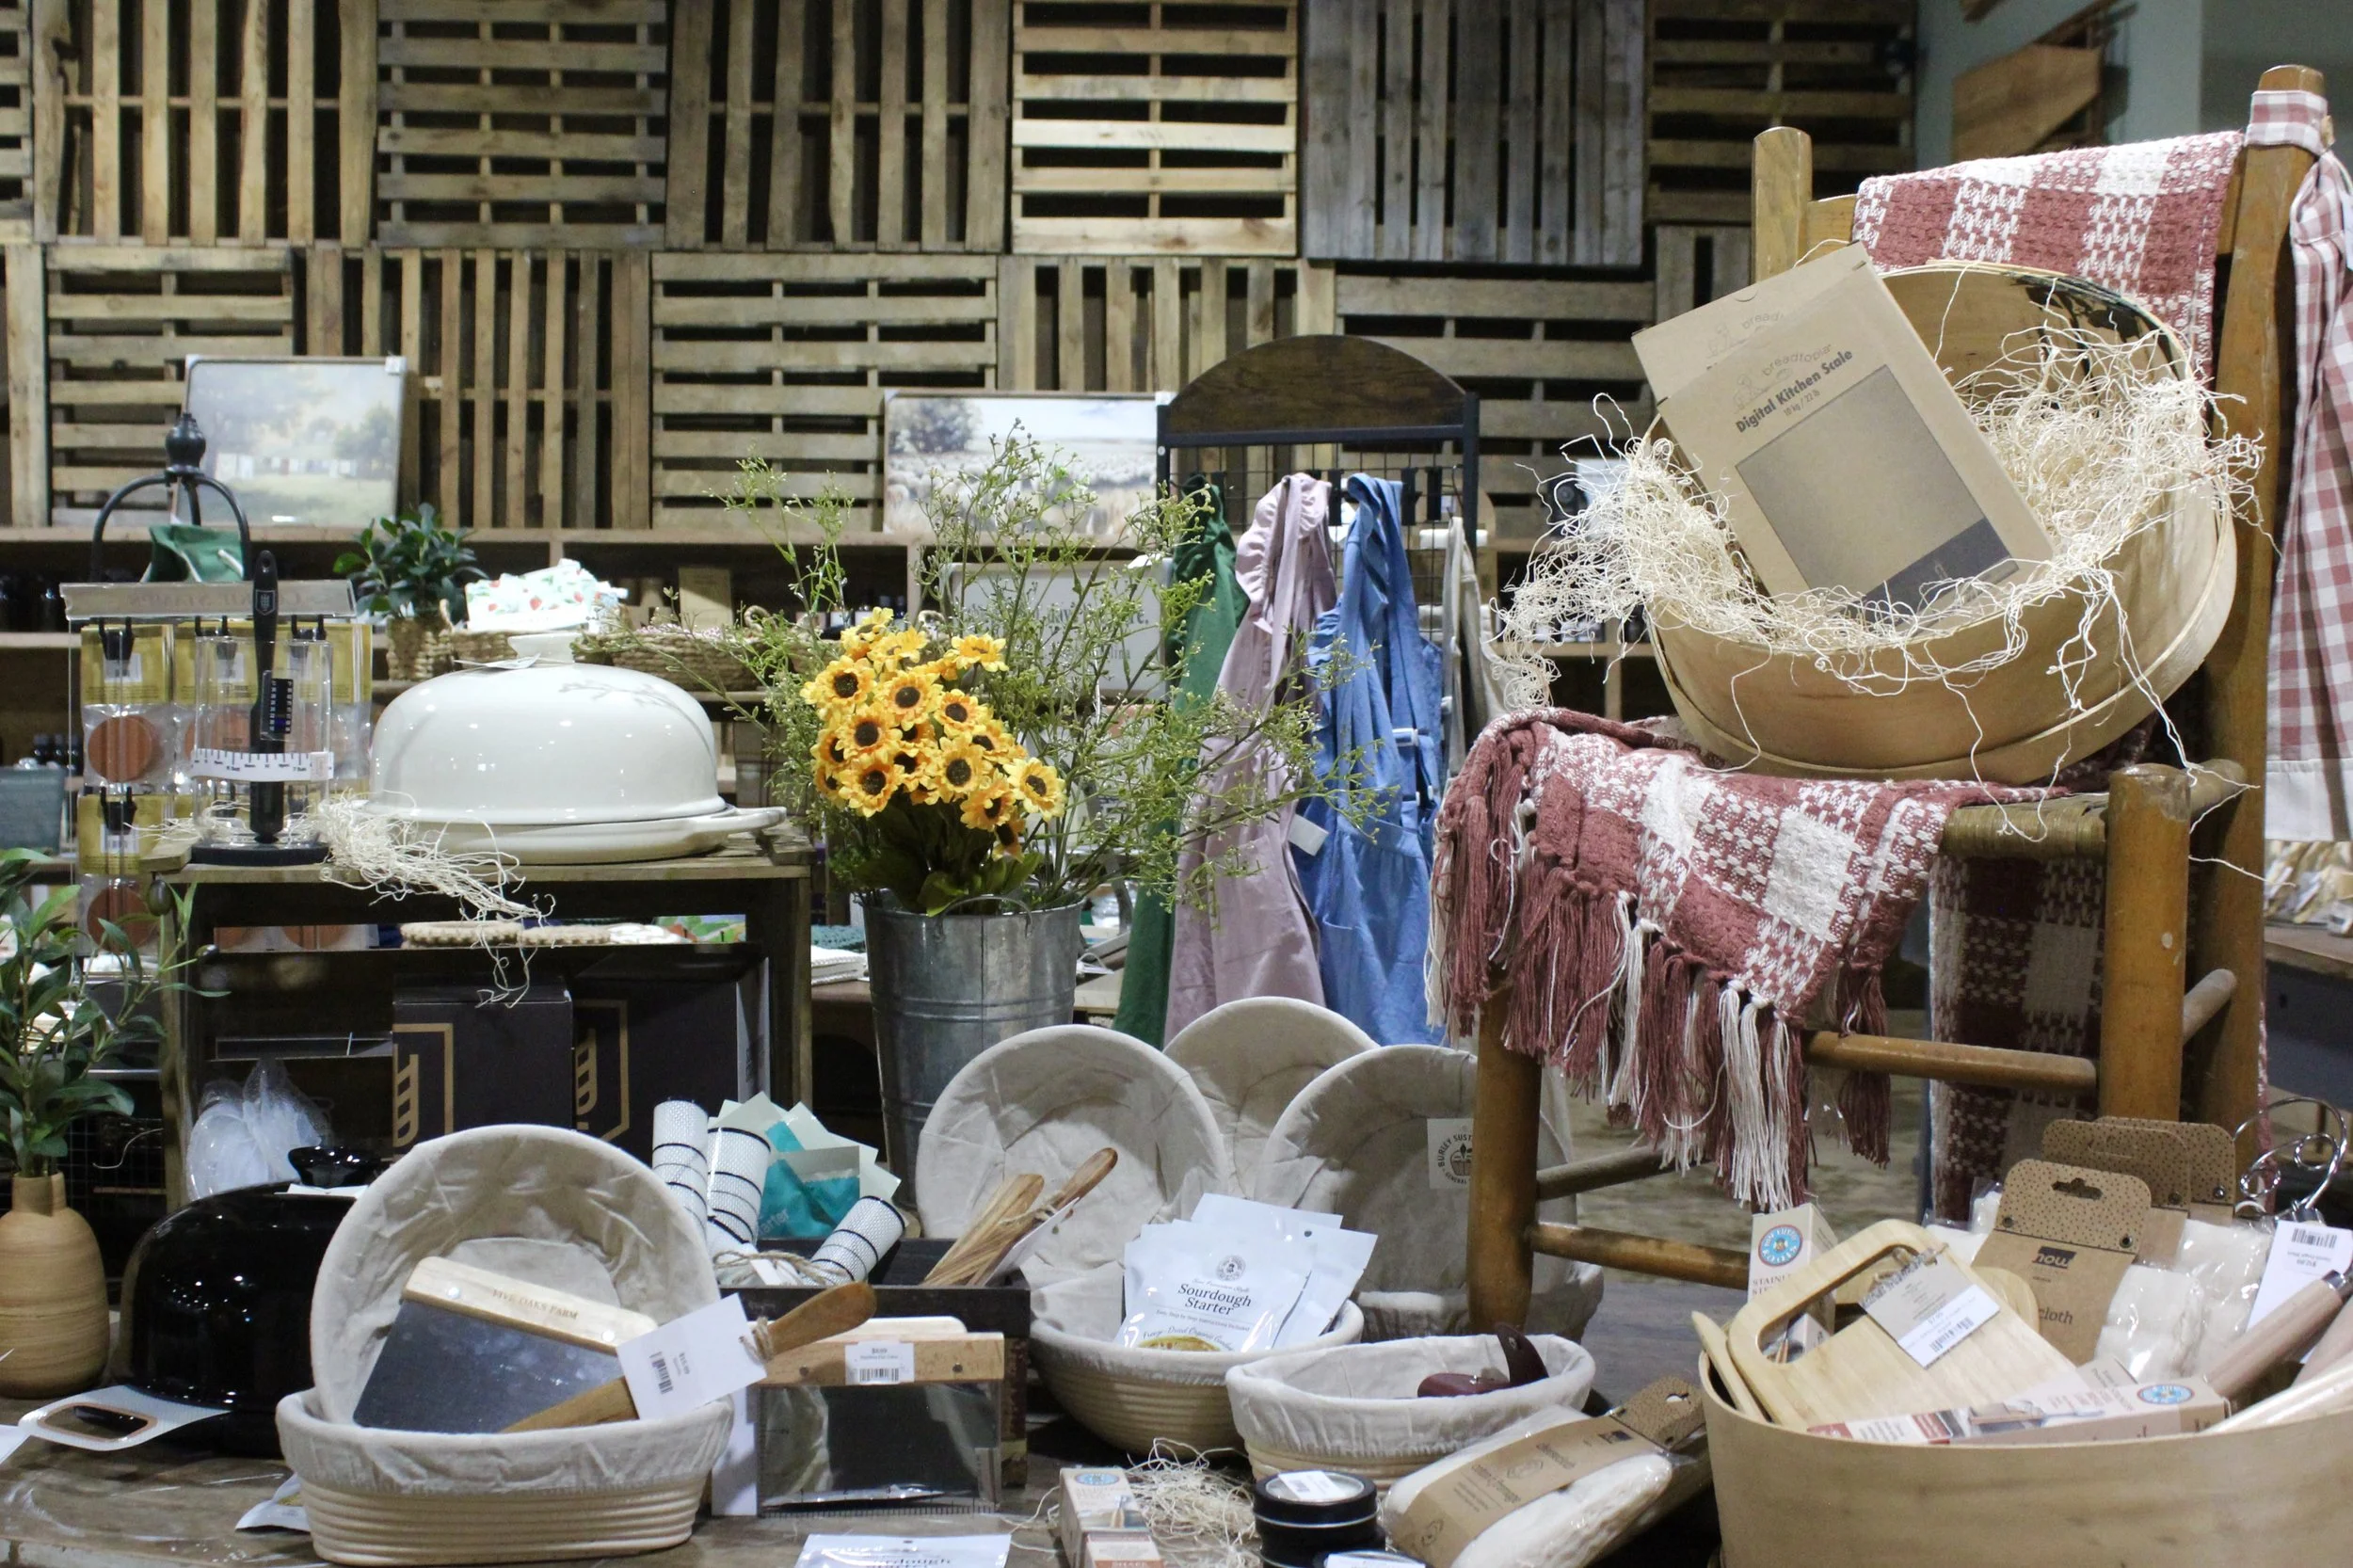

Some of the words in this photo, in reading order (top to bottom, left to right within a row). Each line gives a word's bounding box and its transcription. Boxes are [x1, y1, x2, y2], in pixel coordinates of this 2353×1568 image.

[1736, 399, 1777, 433] Digital
[1775, 372, 1822, 406] Kitchen
[1821, 349, 1853, 376] Scale
[492, 1288, 514, 1303] FIVE
[520, 1298, 547, 1311] OAKS
[549, 1305, 579, 1320] FARM
[1177, 1284, 1252, 1308] Sourdough
[1184, 1297, 1235, 1316] Starter
